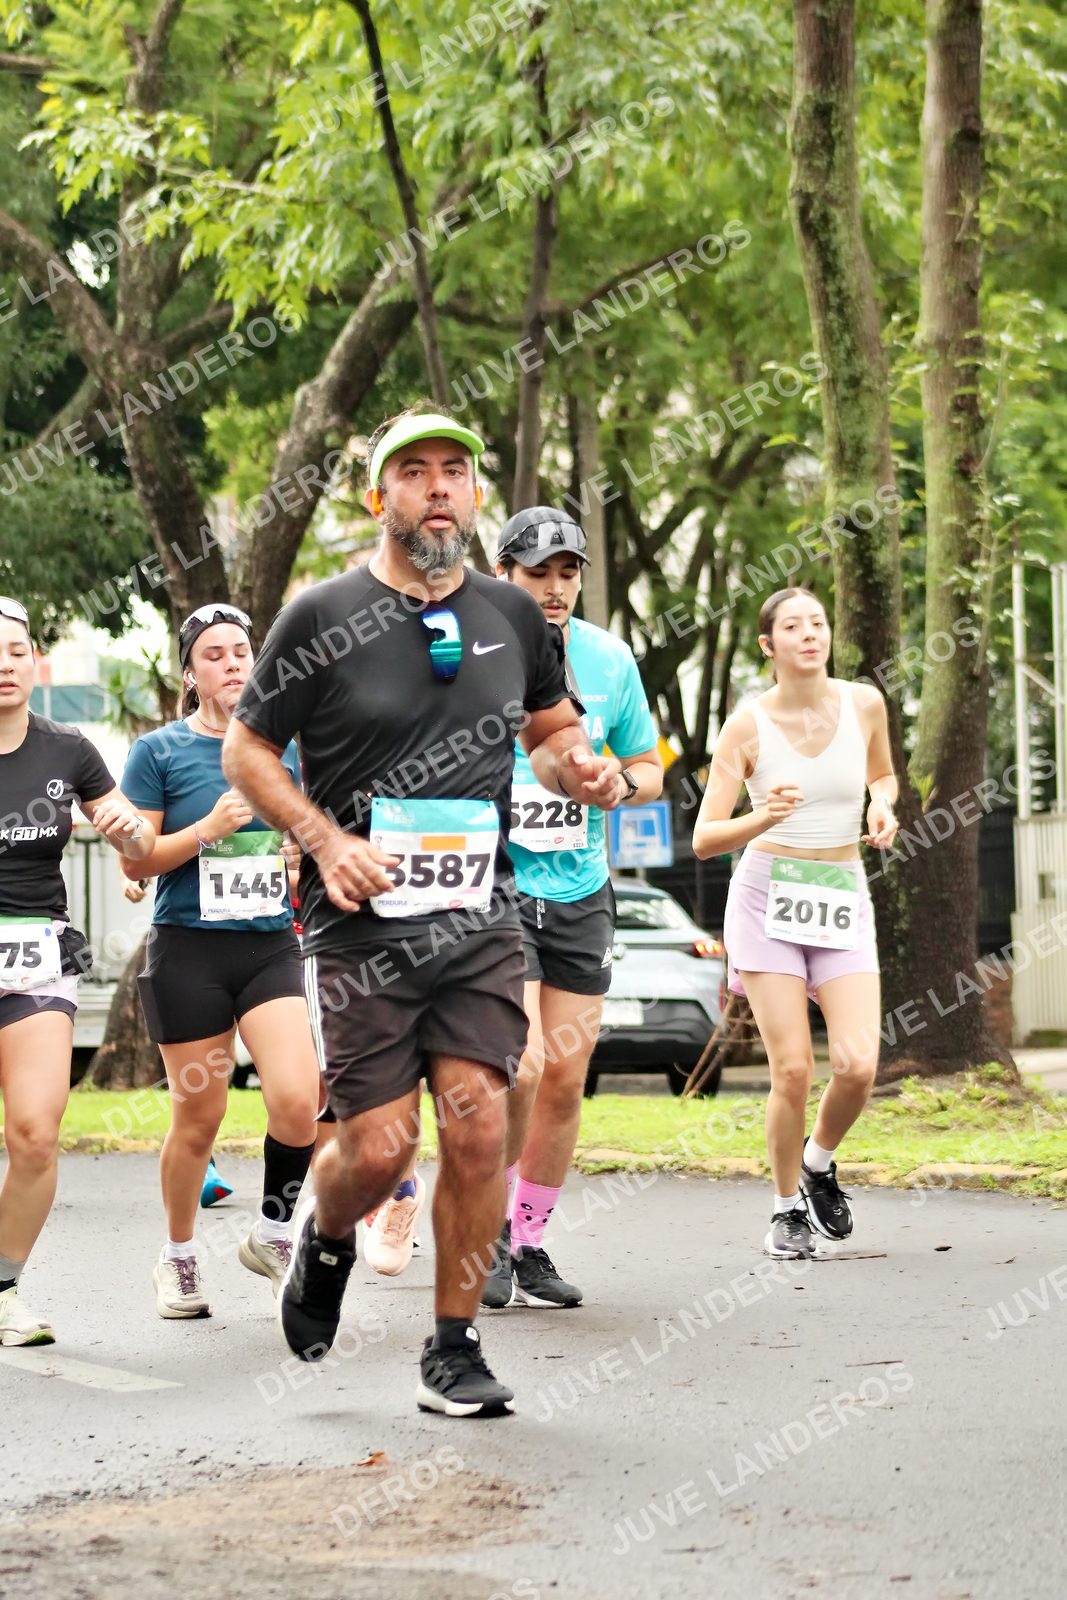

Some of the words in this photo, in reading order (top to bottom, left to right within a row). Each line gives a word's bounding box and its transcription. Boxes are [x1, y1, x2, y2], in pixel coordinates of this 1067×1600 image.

[12, 827, 38, 840] FIT
[39, 826, 58, 838] MX
[210, 872, 282, 898] 1445
[773, 896, 851, 930] 2016
